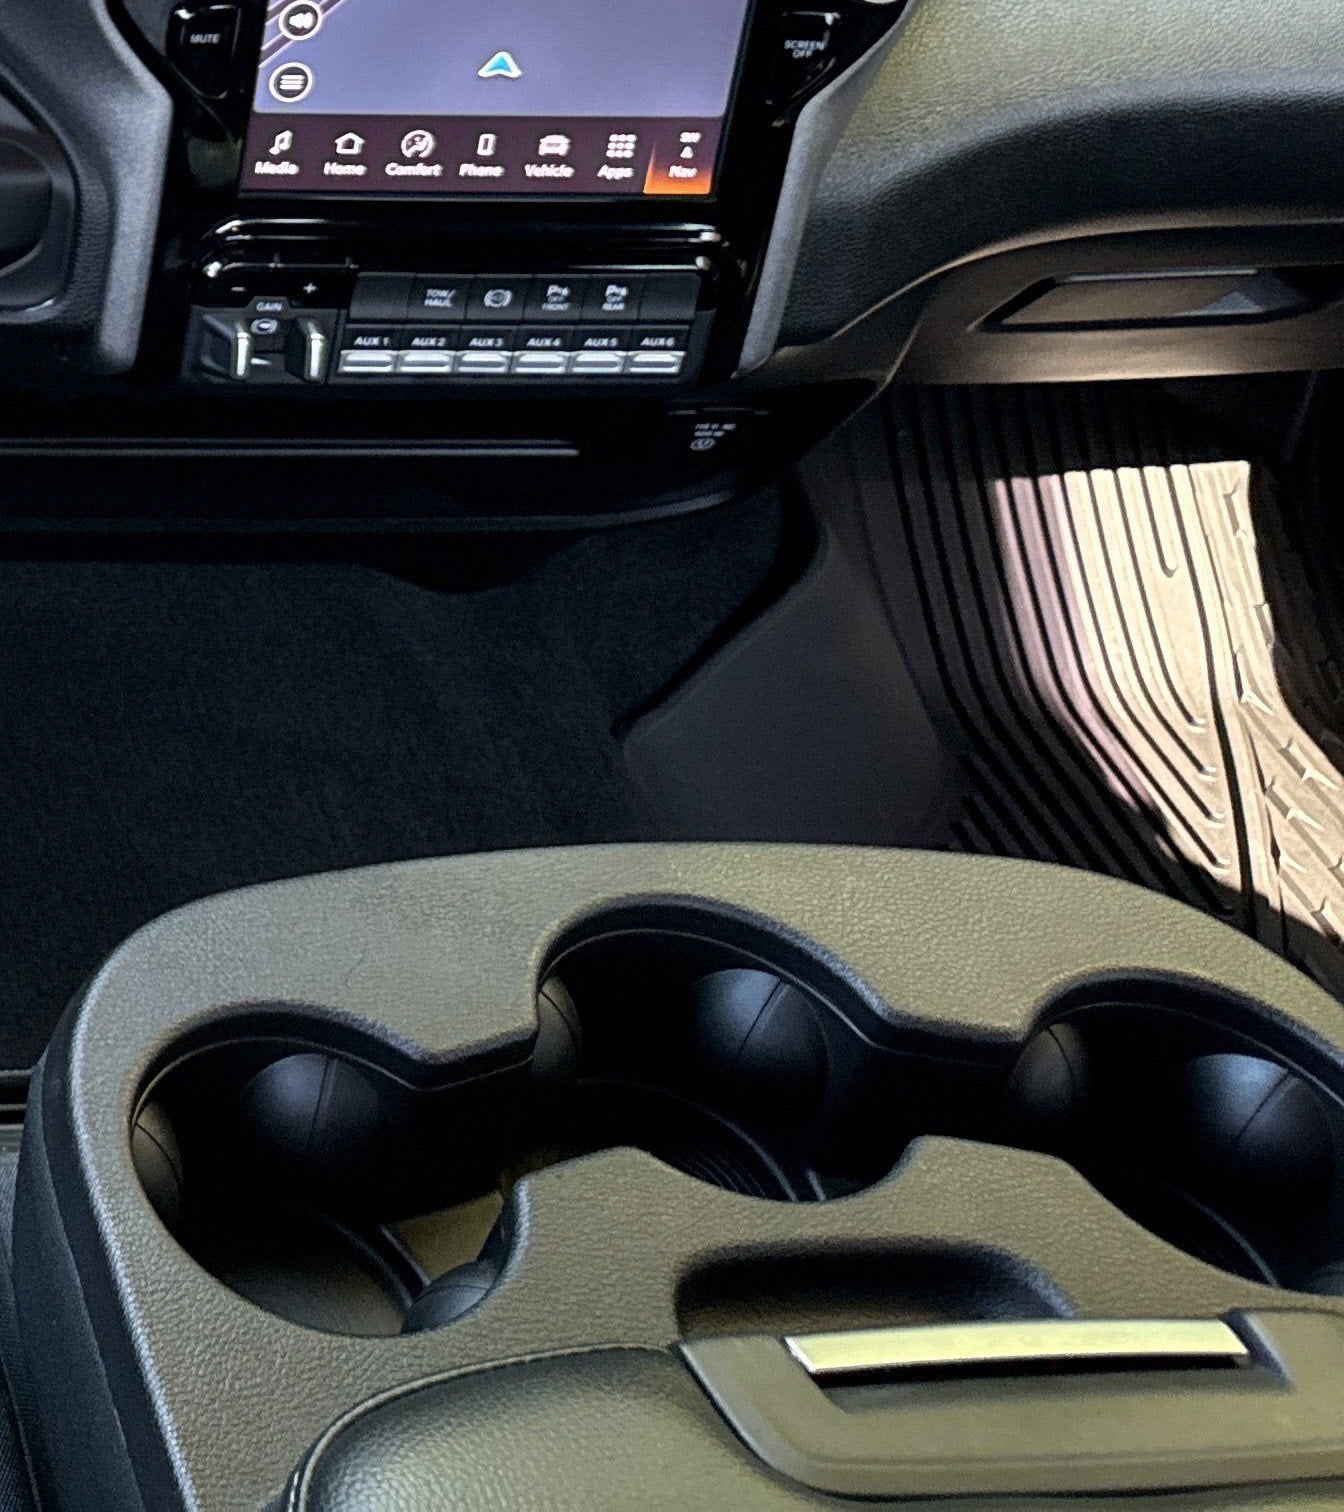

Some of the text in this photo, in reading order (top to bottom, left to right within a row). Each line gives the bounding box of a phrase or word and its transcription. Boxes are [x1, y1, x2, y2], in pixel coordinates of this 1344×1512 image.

[190, 33, 220, 44] MUTE
[784, 40, 824, 50] SCREEN
[792, 50, 813, 59] OFF
[254, 161, 299, 175] Media
[324, 162, 367, 175] Home
[385, 162, 443, 176] Comfort
[459, 163, 505, 177] Phone
[524, 164, 575, 178] Vehicle
[596, 164, 634, 180] Apps
[668, 165, 697, 178] Nav
[255, 302, 283, 311] GAIN
[354, 337, 380, 347] AUX
[411, 337, 438, 347] AUX
[469, 337, 496, 347] AUX
[526, 337, 553, 347] AUX
[584, 337, 610, 347] AUX
[640, 337, 666, 347] AUX
